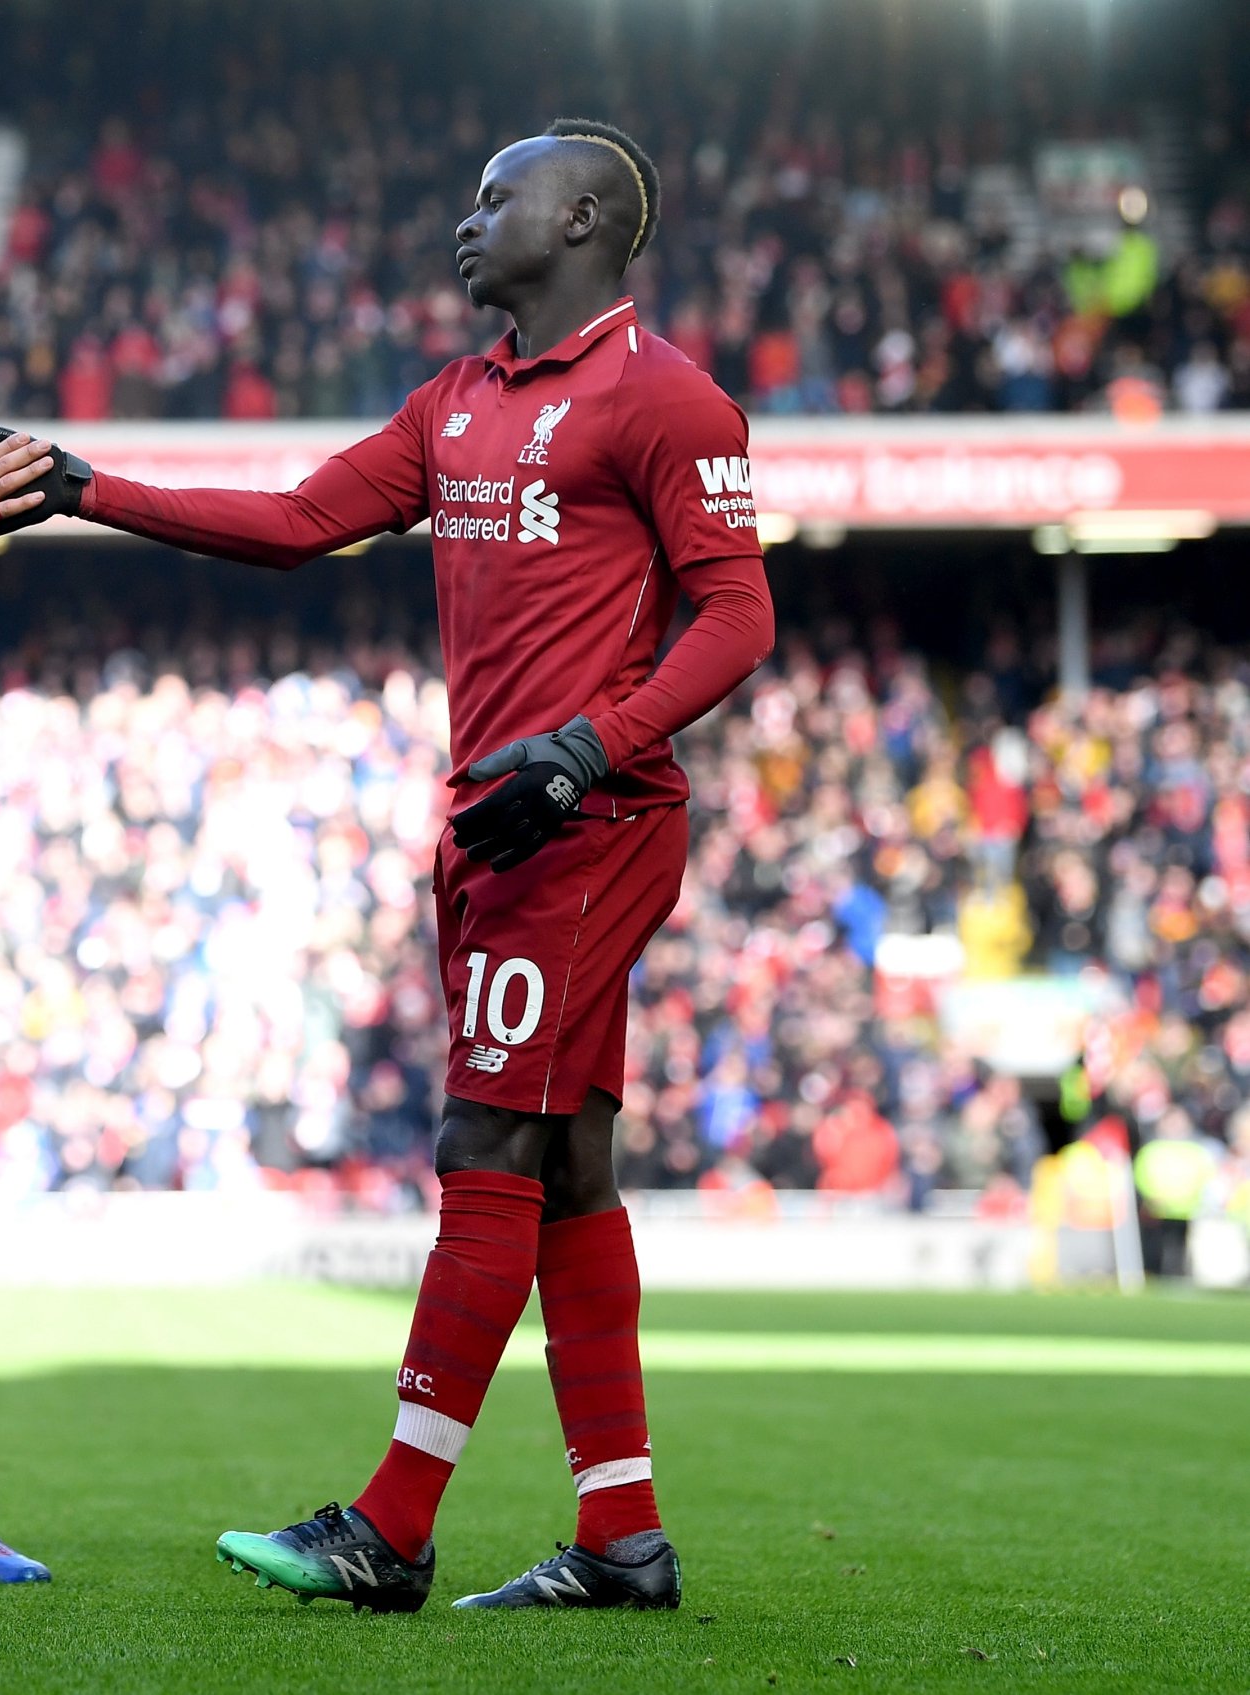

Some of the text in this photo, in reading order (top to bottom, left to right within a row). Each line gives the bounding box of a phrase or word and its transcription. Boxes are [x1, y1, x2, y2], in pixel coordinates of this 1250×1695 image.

[437, 473, 516, 505] Standard
[435, 509, 511, 542] Chartered
[462, 952, 545, 1045] 10
